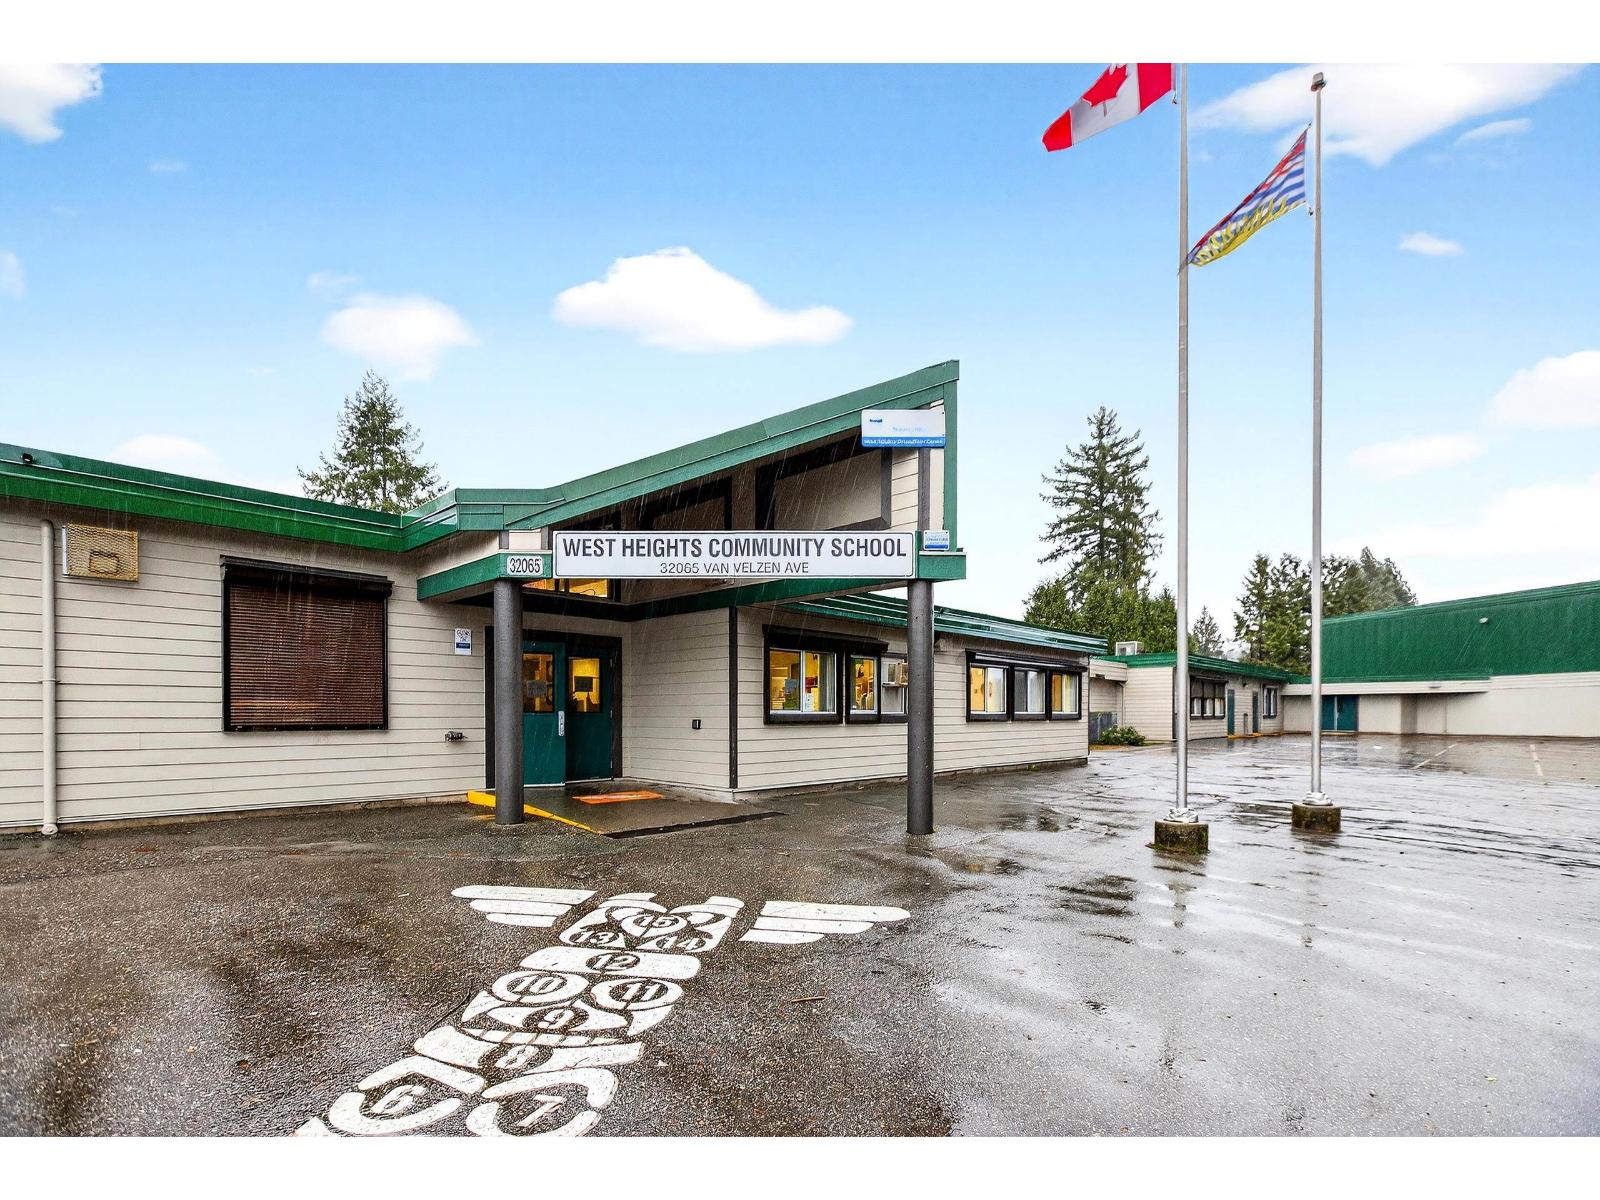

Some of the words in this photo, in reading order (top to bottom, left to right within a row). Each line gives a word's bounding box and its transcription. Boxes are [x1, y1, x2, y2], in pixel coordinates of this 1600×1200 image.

[563, 538, 616, 557] WEST
[622, 538, 702, 558] HEIGHTS
[708, 538, 825, 558] COMMUNITY
[831, 538, 906, 557] SCHOOL
[509, 557, 541, 574] 32065
[660, 562, 699, 574] 32065
[703, 562, 729, 574] VAN
[734, 562, 781, 574] VELZEN
[784, 561, 809, 574] AVE
[638, 914, 679, 928] 15
[574, 930, 620, 944] 13
[660, 935, 706, 951] 14
[592, 953, 639, 970] 12
[513, 974, 564, 994] 10
[620, 983, 665, 1002] 11
[537, 1009, 575, 1029] 9
[495, 1044, 540, 1069] 8
[369, 1084, 425, 1115] 6
[516, 1094, 567, 1127] 7
